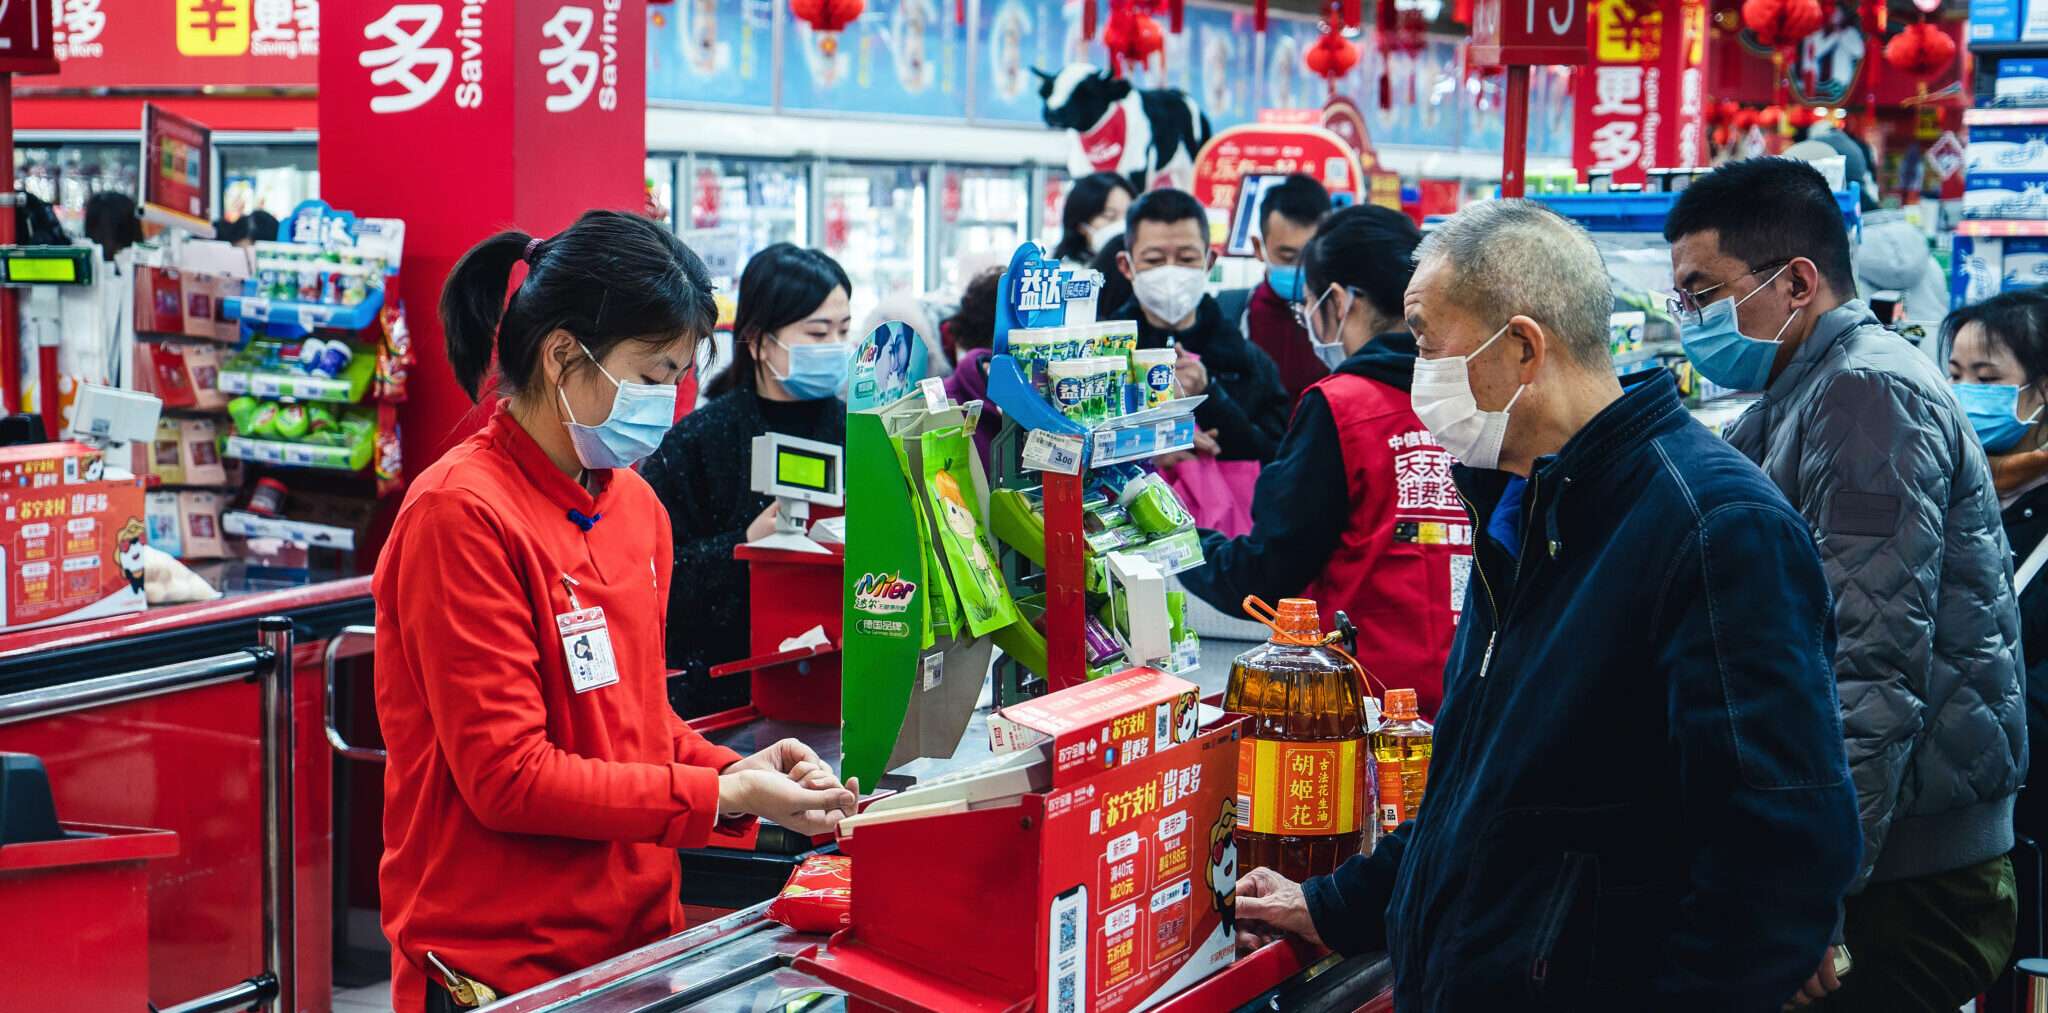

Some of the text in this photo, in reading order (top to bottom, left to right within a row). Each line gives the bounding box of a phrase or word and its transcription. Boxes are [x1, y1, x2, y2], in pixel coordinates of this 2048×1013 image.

[359, 4, 453, 113] 多
[455, 0, 484, 109] Savin
[539, 6, 600, 112] 多
[1018, 268, 1062, 311] 益达
[1388, 429, 1441, 451] 中信银
[1107, 780, 1156, 828] 苏宁支付
[1289, 755, 1314, 826] 胡姬花
[1317, 758, 1330, 822] 古法花生油
